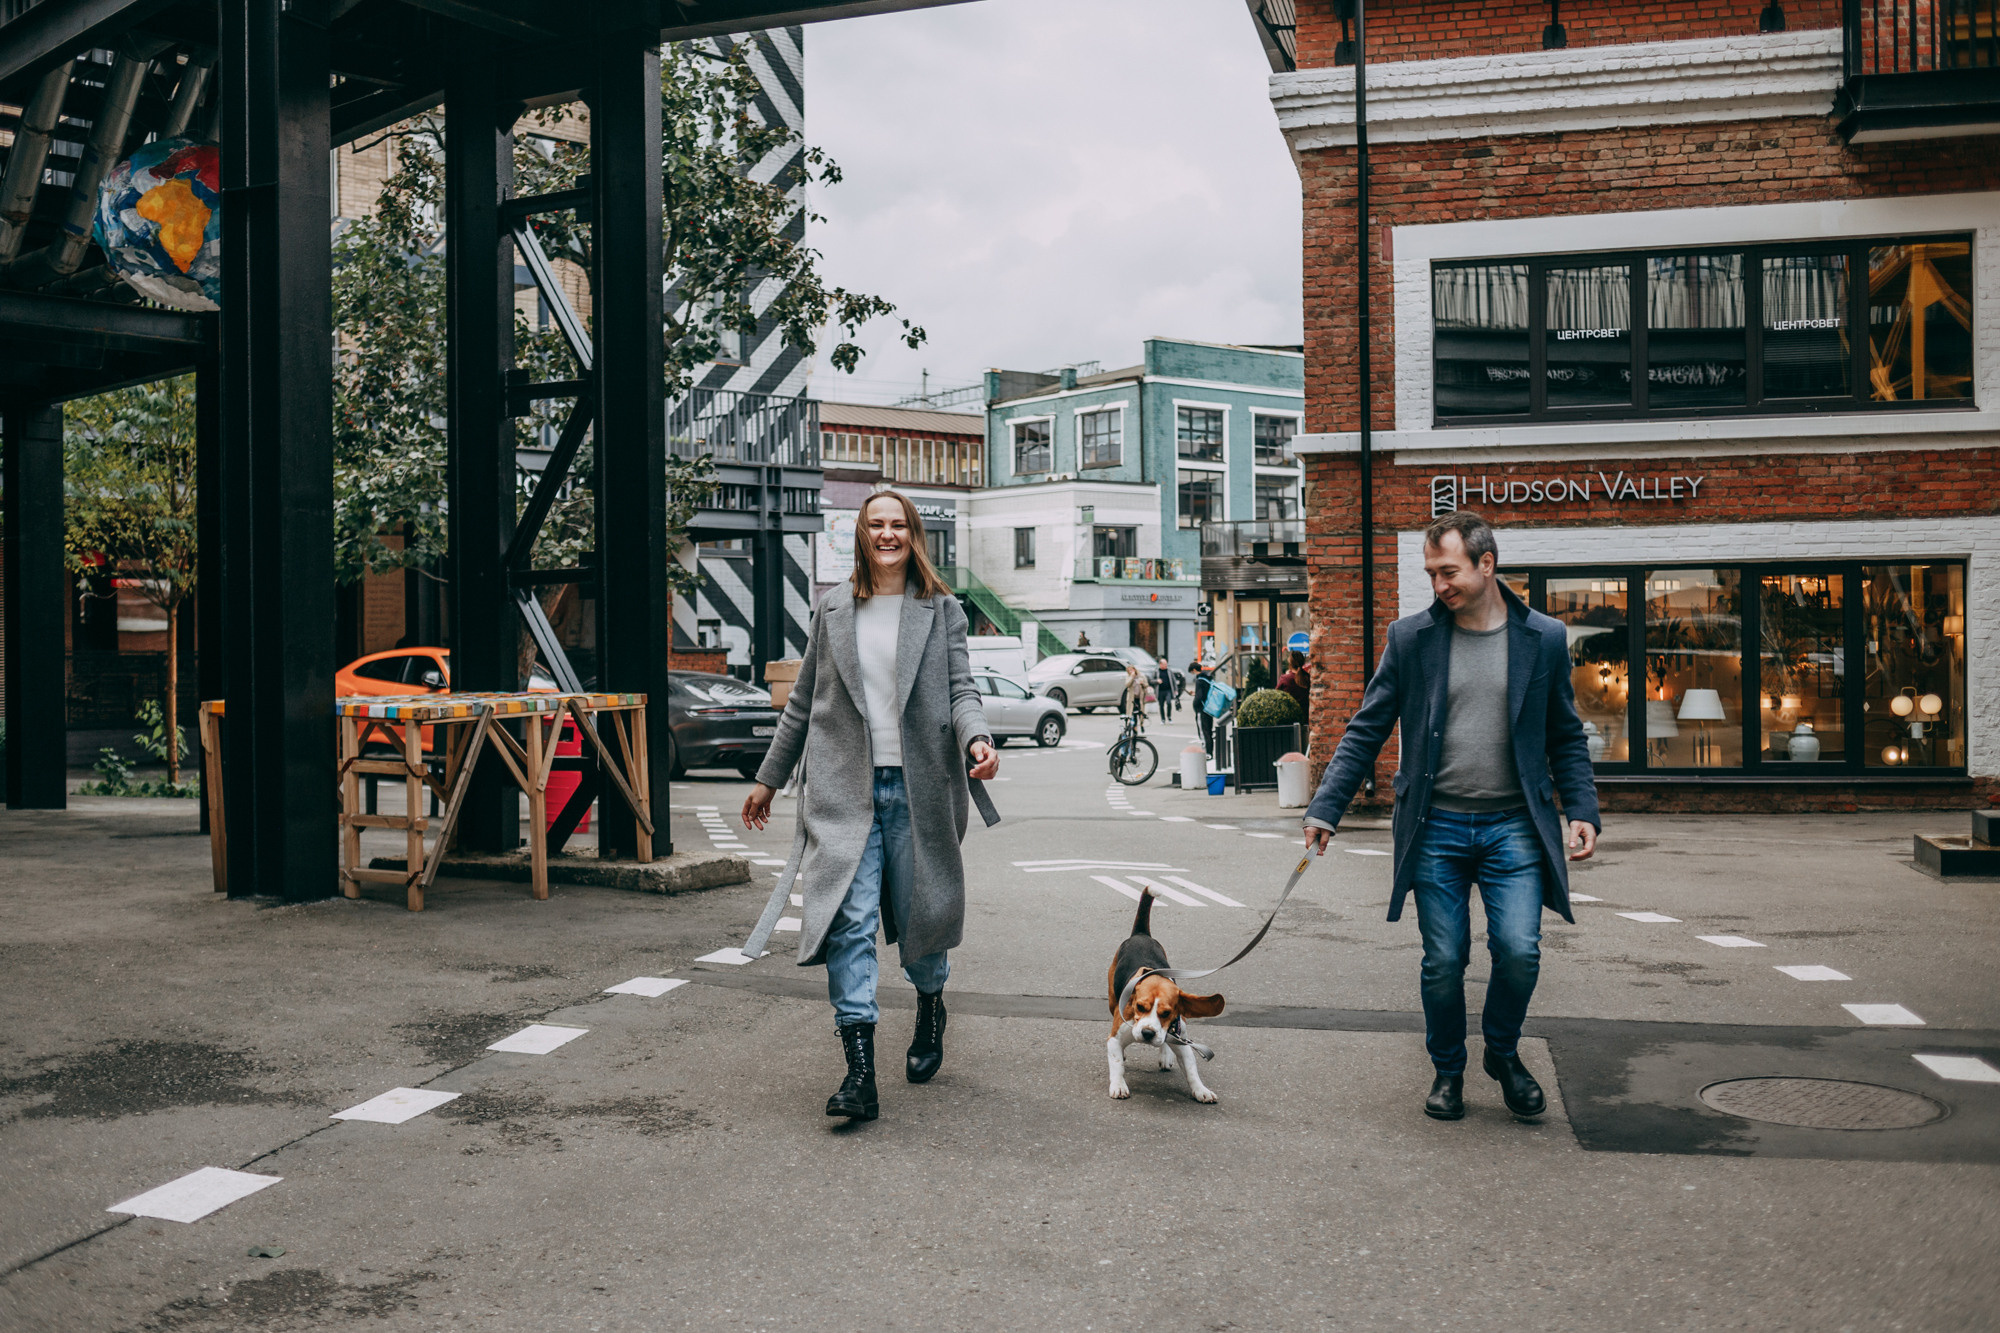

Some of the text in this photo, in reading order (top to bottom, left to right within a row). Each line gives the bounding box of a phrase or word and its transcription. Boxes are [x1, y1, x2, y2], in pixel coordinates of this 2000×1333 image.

[1773, 318, 1840, 331] ЦЕНТРСВЕТ
[1557, 328, 1621, 340] ЦЕНТРСВЕТ
[1462, 470, 1704, 504] HUDSON VALLEY
